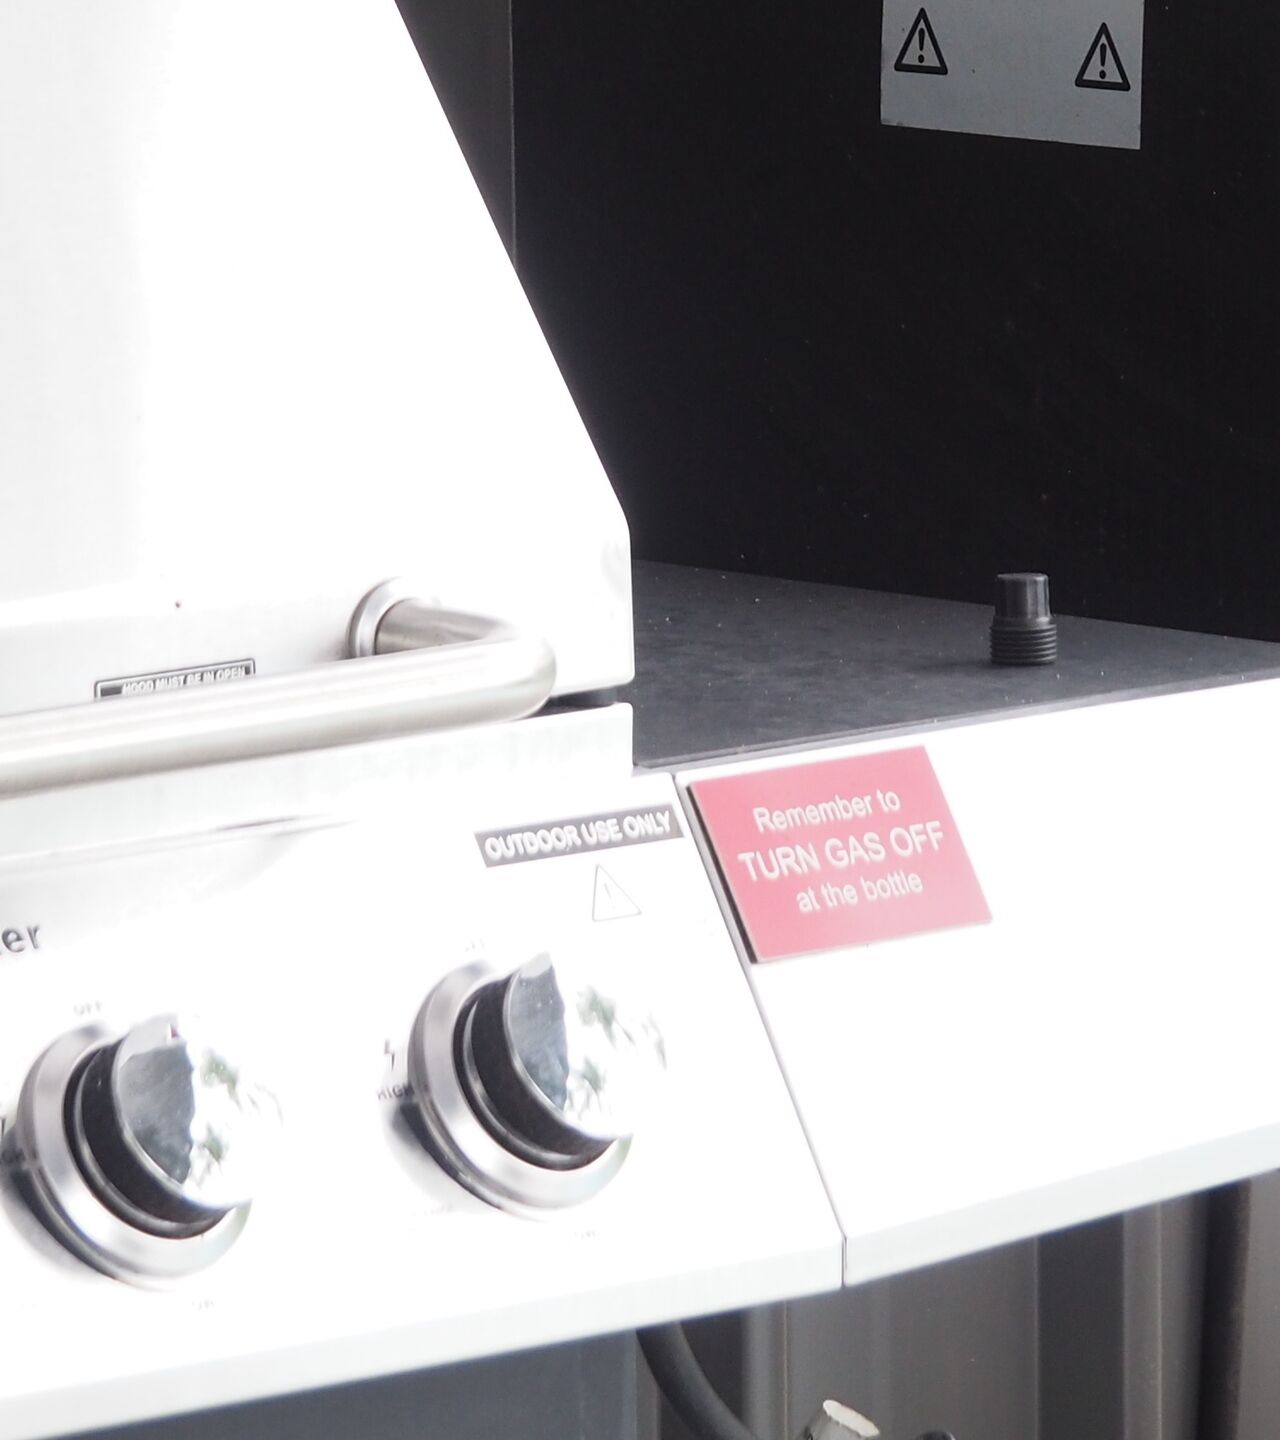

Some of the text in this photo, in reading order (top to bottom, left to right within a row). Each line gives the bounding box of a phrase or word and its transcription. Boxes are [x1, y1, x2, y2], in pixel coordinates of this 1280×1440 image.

[121, 664, 247, 696] HOOD MUST BE IN OPEN
[752, 787, 901, 833] Remember to
[484, 810, 671, 861] OUTDOOR USE ONLY
[737, 819, 944, 882] TURN GAS OFF
[795, 868, 924, 913] at the bottle
